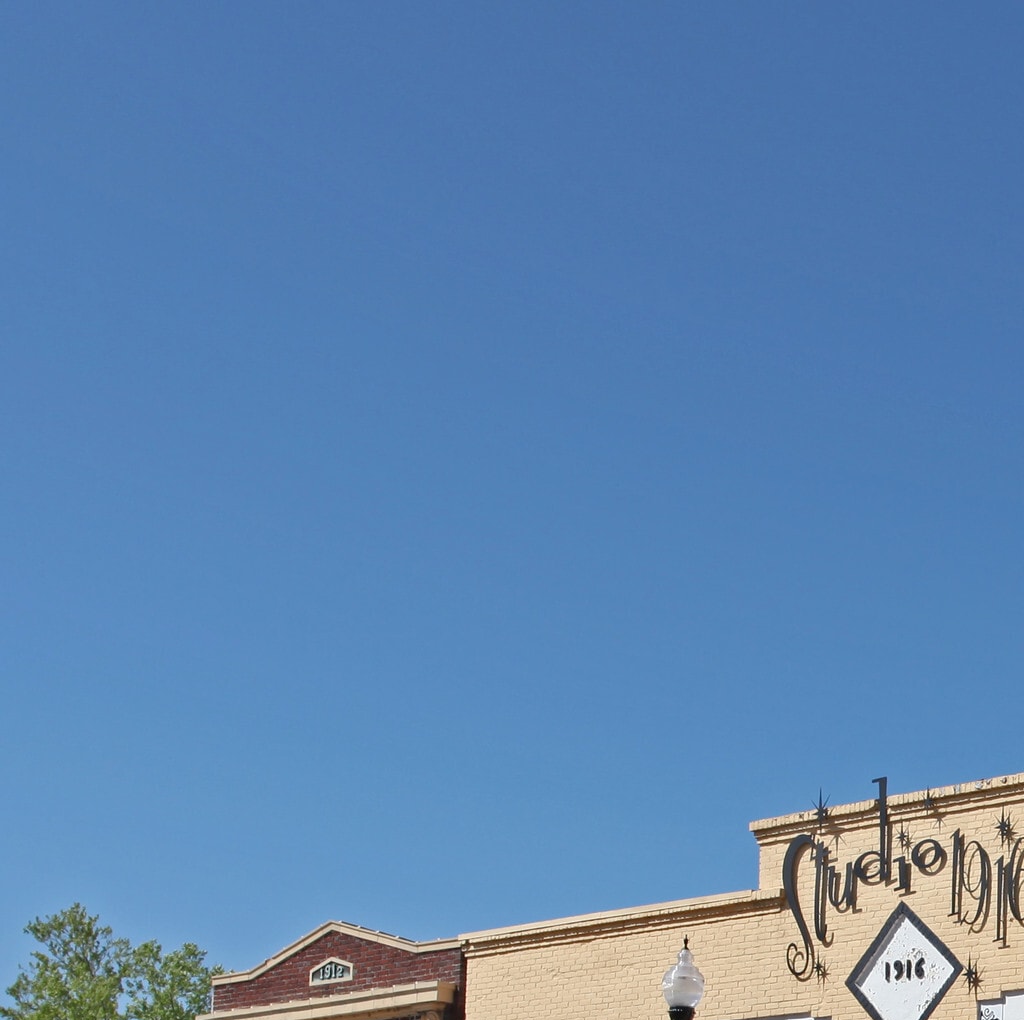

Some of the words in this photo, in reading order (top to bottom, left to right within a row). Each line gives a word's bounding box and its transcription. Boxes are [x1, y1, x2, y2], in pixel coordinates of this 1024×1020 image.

[783, 777, 944, 976] Studio
[320, 963, 344, 980] 1912
[885, 957, 926, 983] 1916
